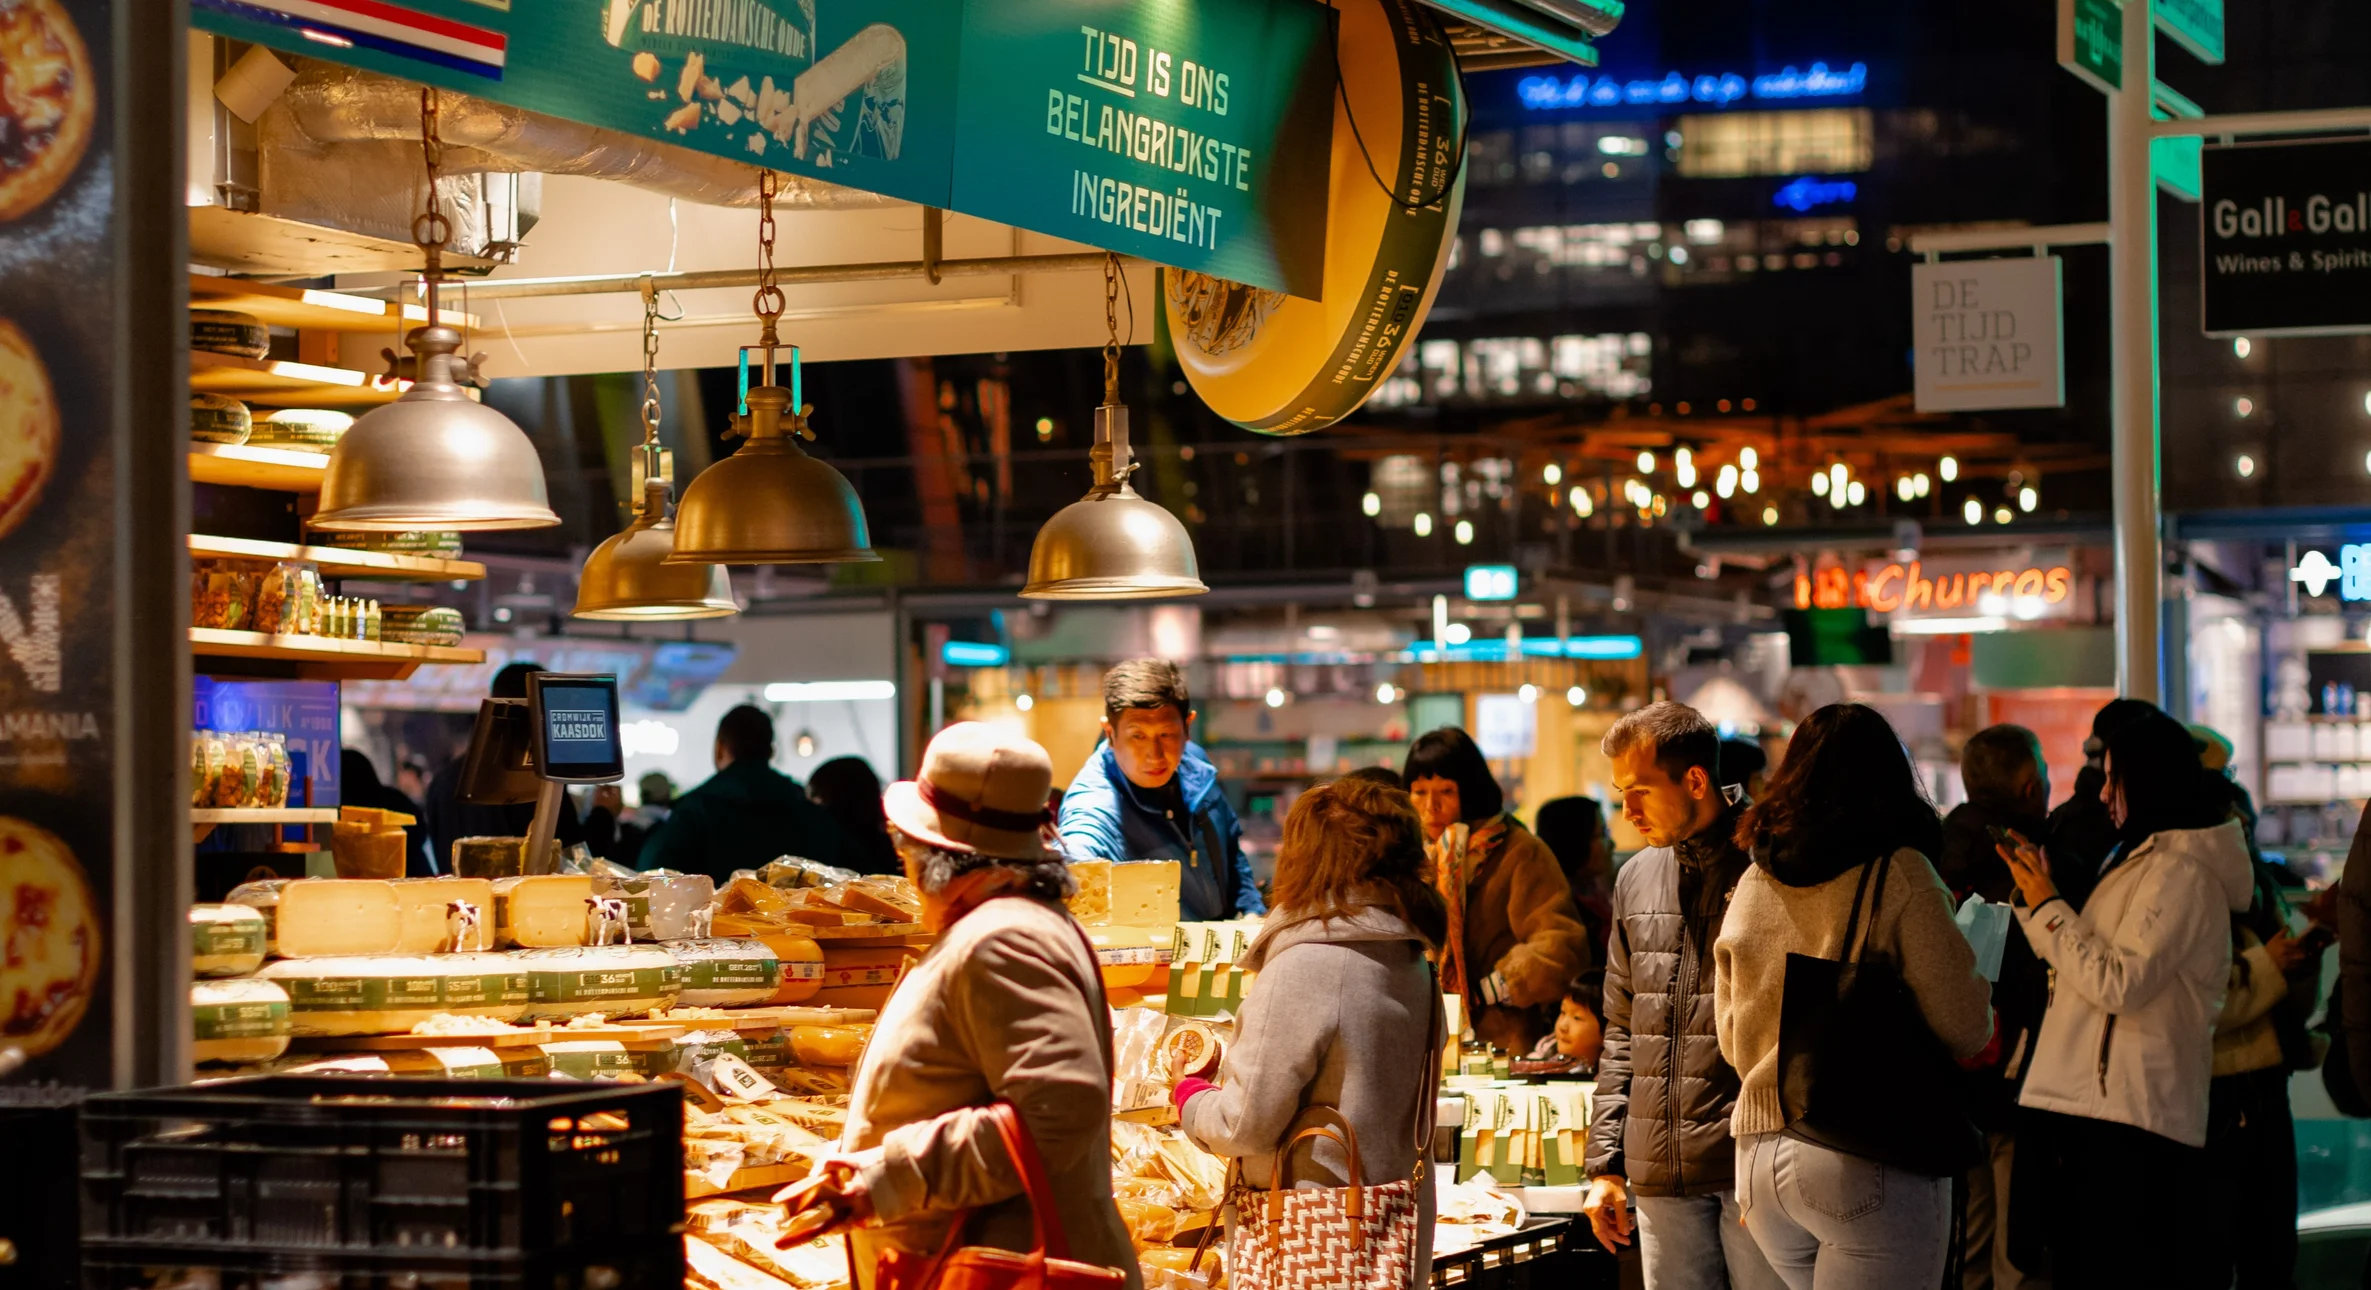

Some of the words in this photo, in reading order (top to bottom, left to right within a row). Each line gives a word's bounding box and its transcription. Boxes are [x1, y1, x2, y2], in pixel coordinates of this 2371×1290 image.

[777, 17, 806, 59] OUDE
[1080, 25, 1137, 87] TIJD
[1147, 48, 1171, 97] IS
[1180, 60, 1230, 117] ONS
[1046, 88, 1251, 192] BELANGRIJKSTE
[1435, 136, 1450, 165] 36
[1072, 169, 1222, 250] INGREDIËNT
[1386, 270, 1399, 284] DE
[2216, 253, 2282, 274] Wines
[2288, 252, 2304, 271] &
[1932, 279, 1979, 310] DE
[1346, 286, 1393, 364] ROTTERDAMSCHE
[1376, 323, 1401, 349] 36
[1931, 310, 2016, 343] TIJD
[1366, 349, 1380, 365] OUD
[1931, 342, 2032, 376] TRAP
[1332, 365, 1352, 385] OUDE
[1869, 560, 2071, 613] Churros
[0, 711, 99, 741] MANIA
[552, 713, 592, 722] CROMWIJK
[553, 723, 605, 738] KAASDOK
[600, 974, 616, 984] 36
[615, 1055, 629, 1064] 36
